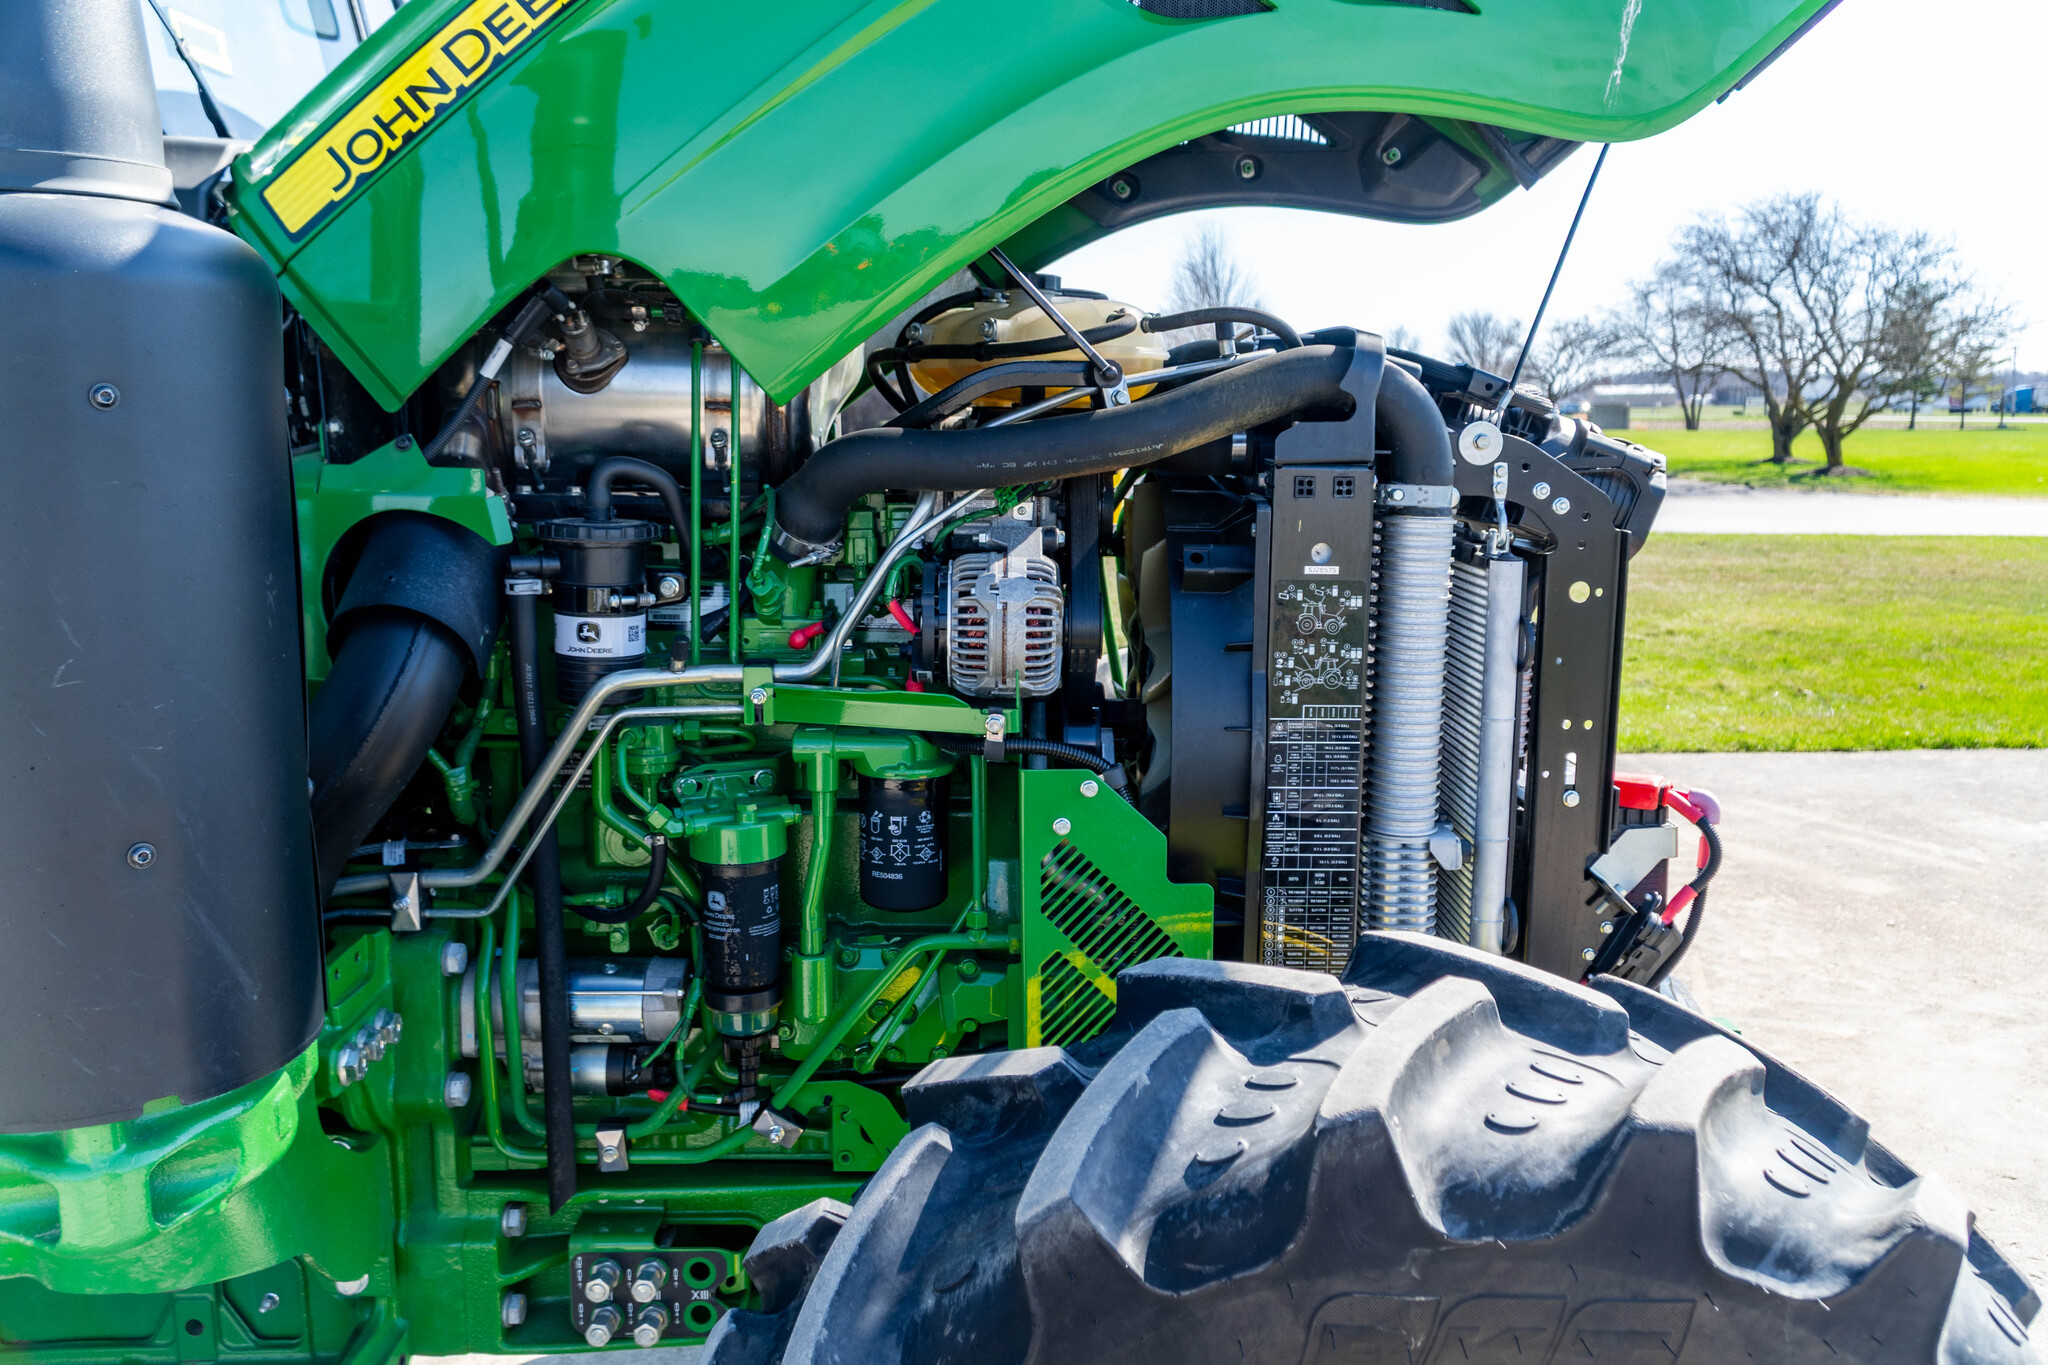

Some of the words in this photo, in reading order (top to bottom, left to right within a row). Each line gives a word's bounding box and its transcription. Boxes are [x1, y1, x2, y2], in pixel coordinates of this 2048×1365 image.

[325, 66, 452, 193] JOHN
[871, 870, 902, 879] RE504836
[690, 1290, 709, 1300] XIII
